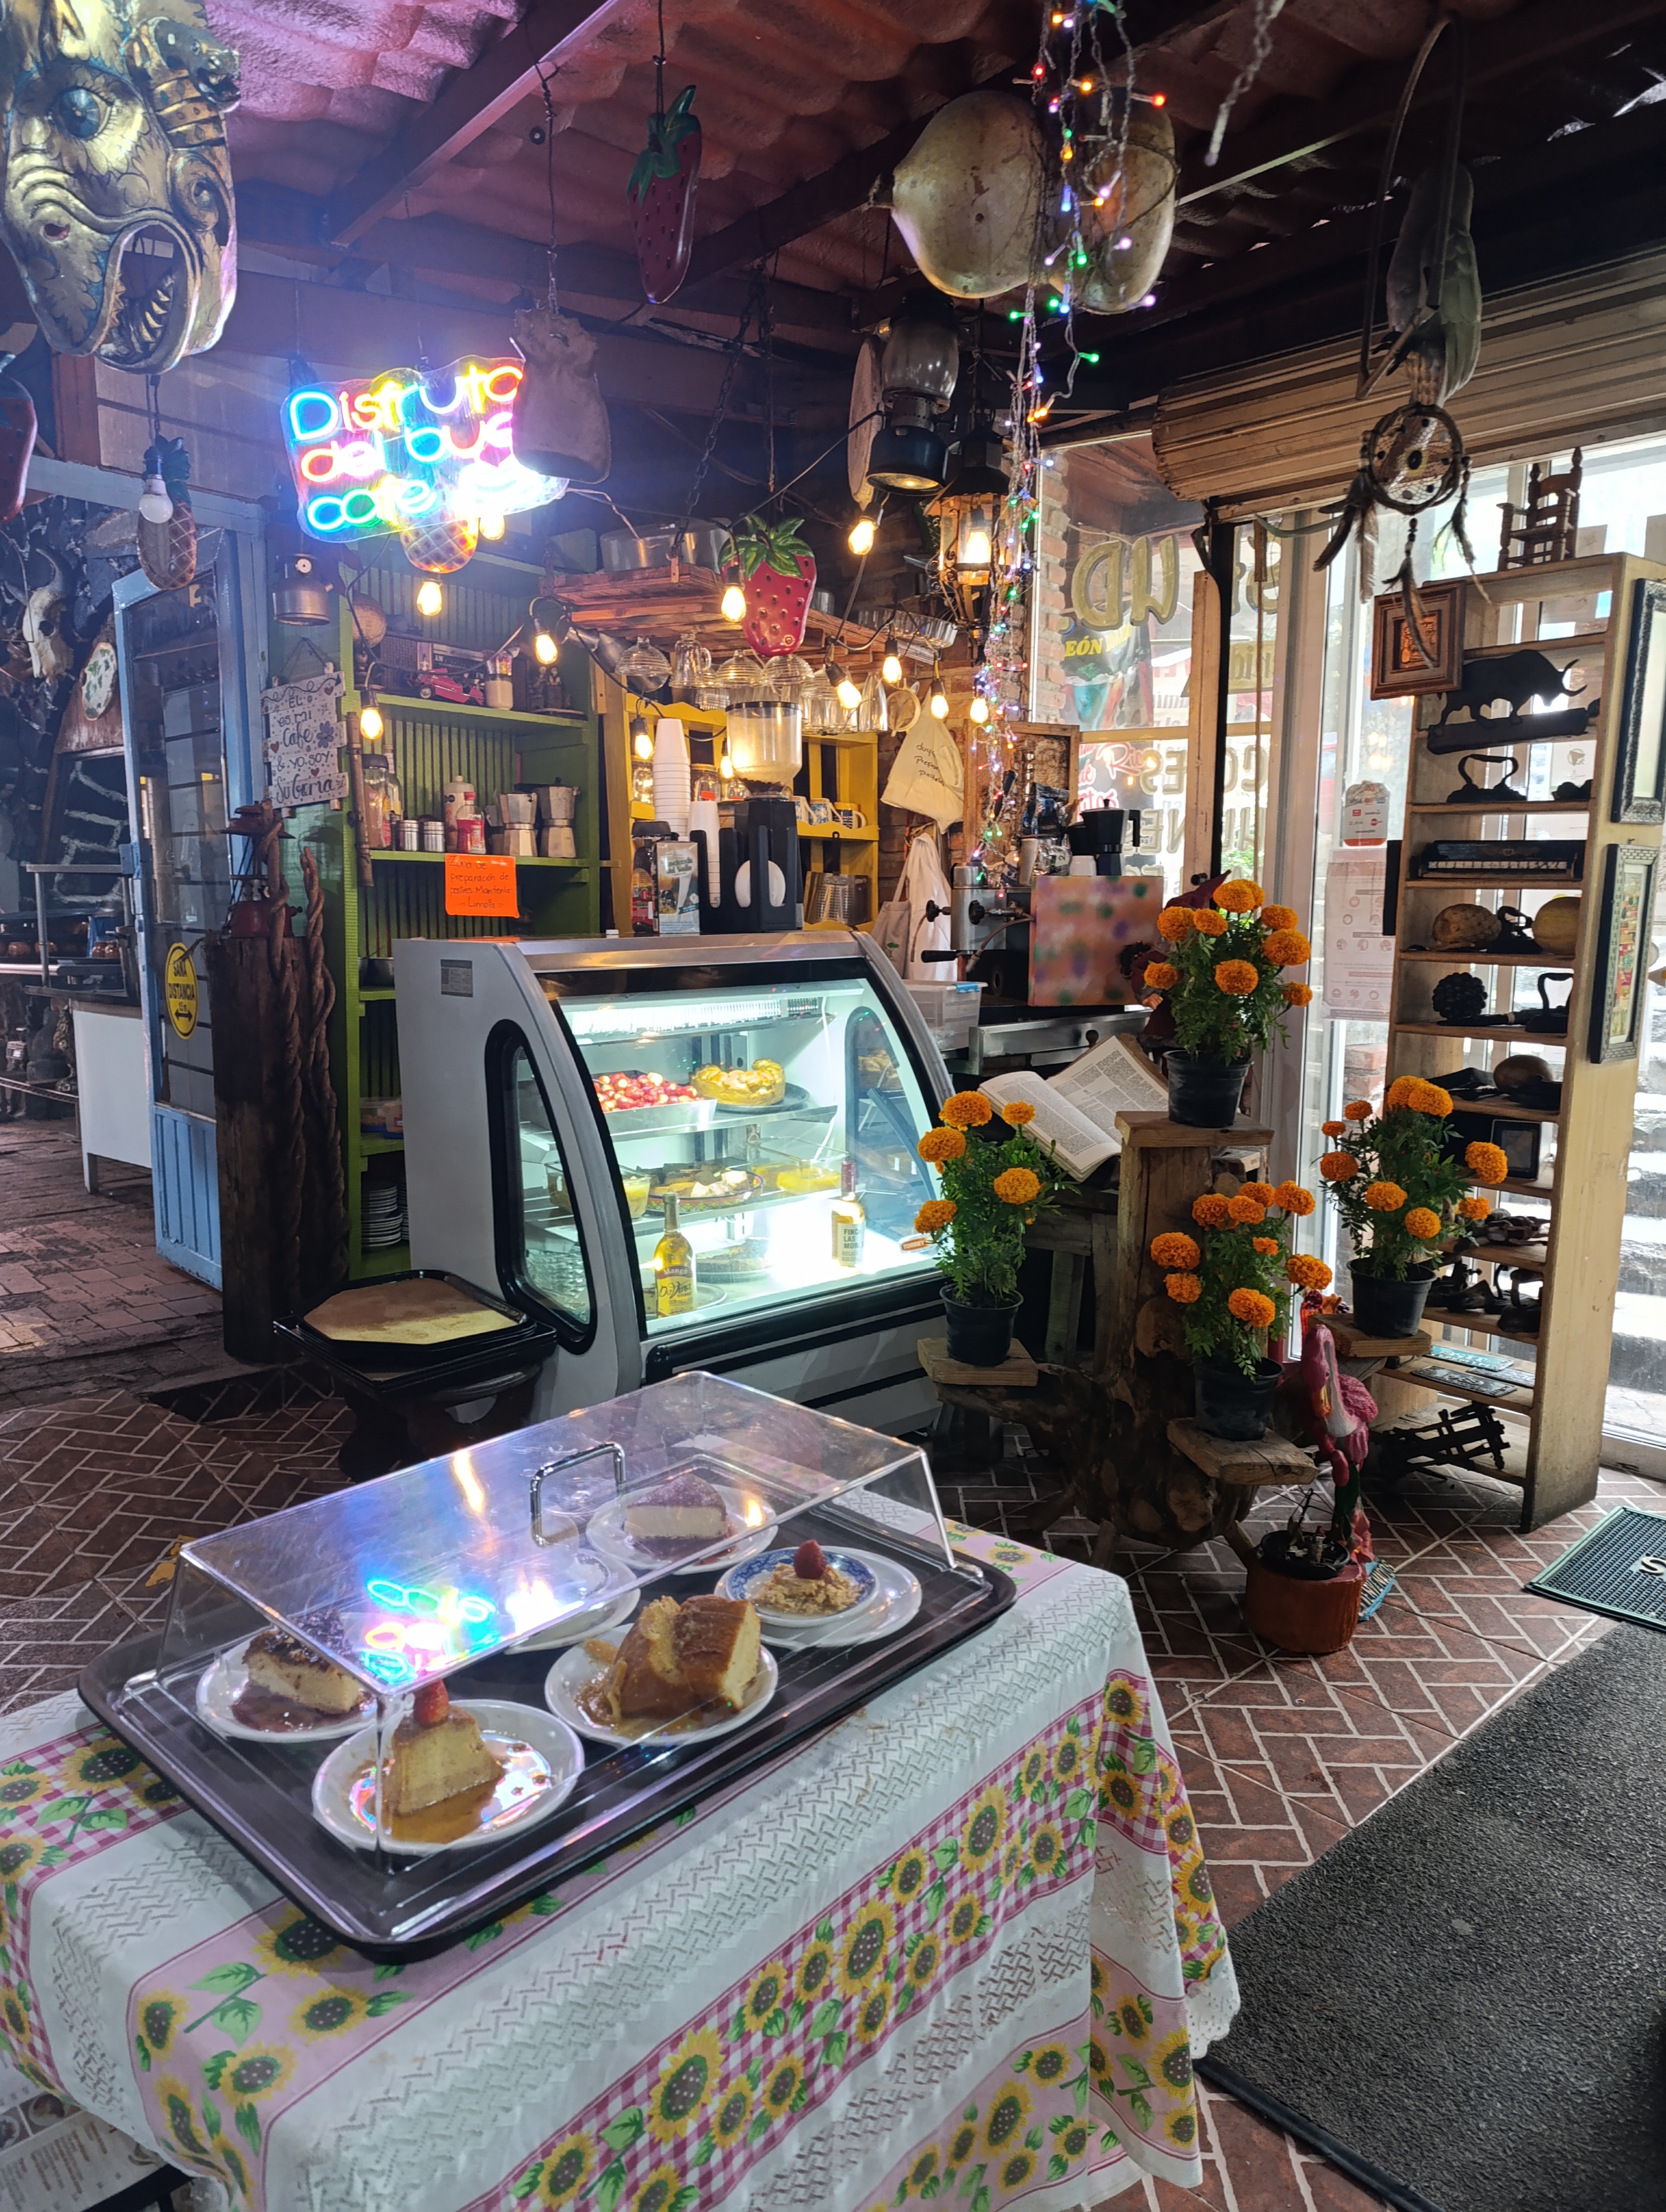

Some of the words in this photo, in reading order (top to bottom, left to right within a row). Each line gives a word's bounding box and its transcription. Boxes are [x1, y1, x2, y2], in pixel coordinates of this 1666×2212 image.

[300, 429, 388, 484] del
[1065, 635, 1104, 657] EÓN
[289, 697, 303, 709] EL
[308, 751, 330, 766] SOY
[663, 1268, 688, 1276] Mango
